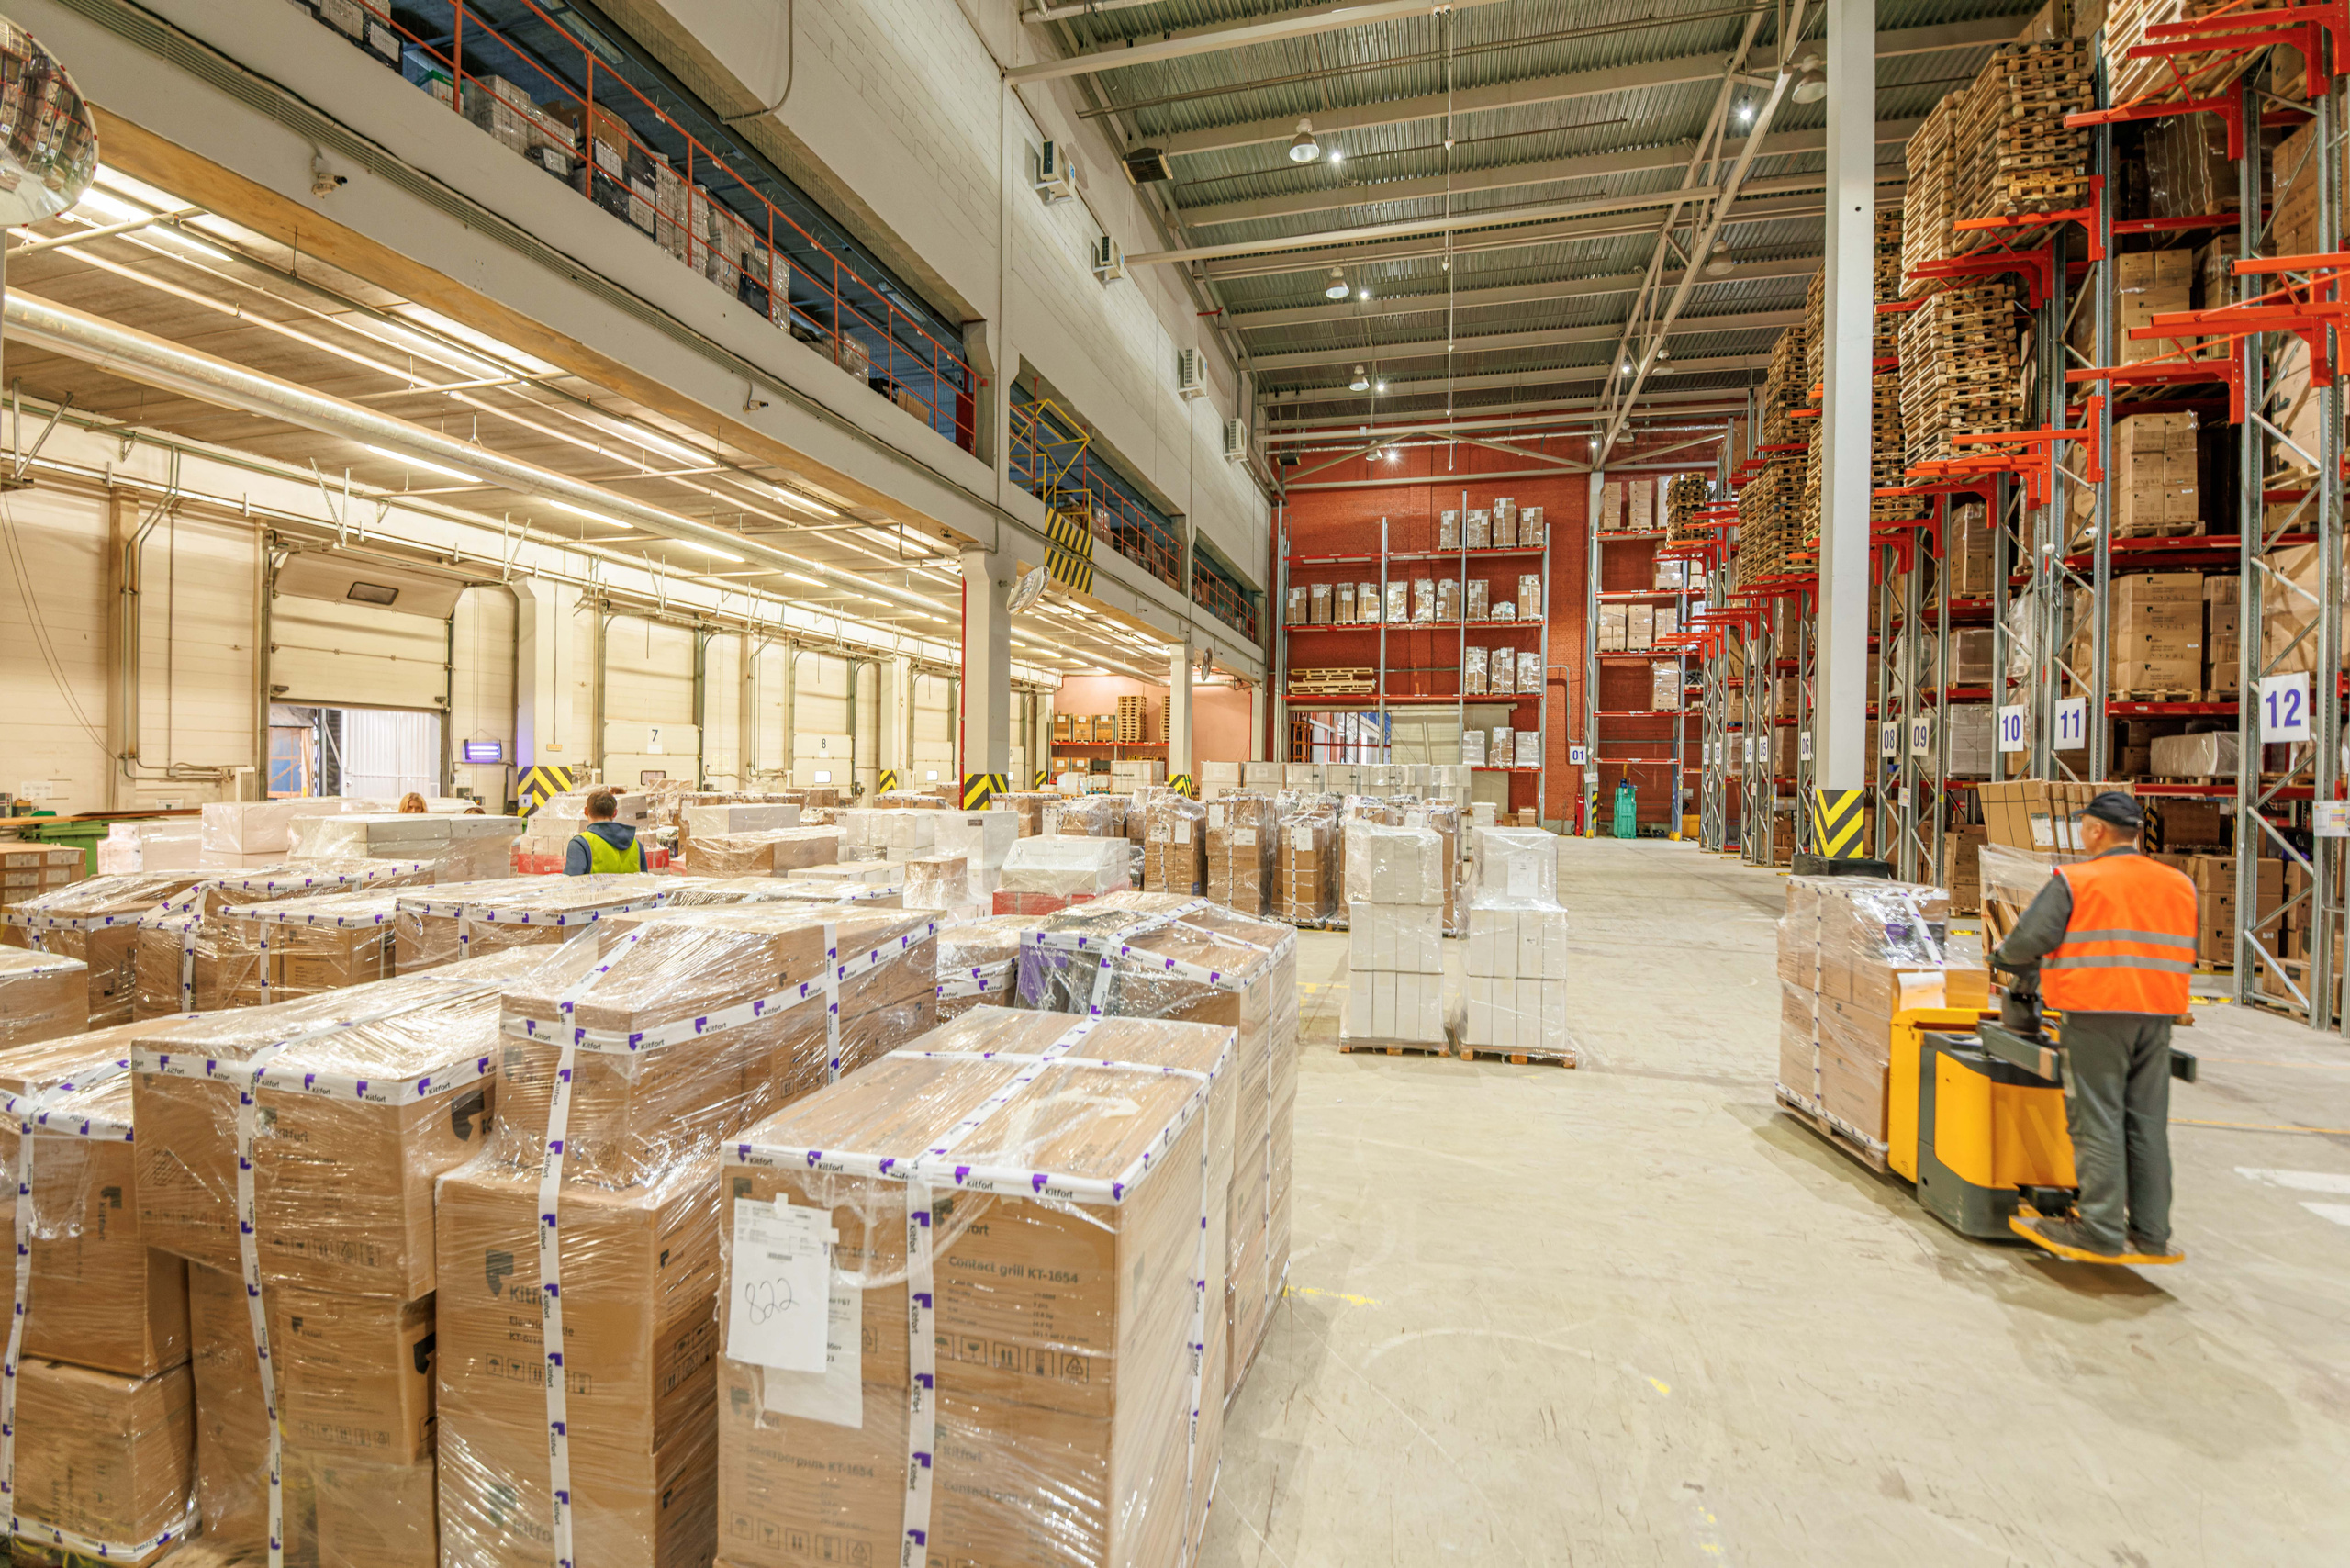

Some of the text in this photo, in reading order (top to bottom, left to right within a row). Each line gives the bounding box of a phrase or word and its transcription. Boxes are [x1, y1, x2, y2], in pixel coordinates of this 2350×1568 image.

[2266, 689, 2301, 728] 12
[2002, 714, 2020, 742] 10
[2060, 709, 2080, 739] 11
[652, 729, 659, 743] 7
[1884, 729, 1895, 750] 08
[1914, 725, 1927, 748] 09
[821, 738, 827, 749] 8
[1802, 737, 1810, 754] 06
[1572, 749, 1584, 761] 01
[763, 1004, 781, 1015] Kitfort
[705, 1023, 727, 1034] Kitfort
[582, 1042, 601, 1050] Kitfort
[641, 1039, 665, 1050] Kitfort
[214, 1072, 230, 1081] Kitfort
[262, 1080, 279, 1089] Kitfort
[429, 1082, 451, 1095] Kitfort
[312, 1087, 331, 1095] Kitfort
[552, 1081, 561, 1106] Kitfort
[365, 1094, 386, 1103] Kitfort
[543, 1152, 552, 1178] Kitfort
[749, 1157, 773, 1166] Kitfort
[818, 1162, 844, 1172] Kitfort
[967, 1179, 993, 1191] Kitfort
[1045, 1187, 1073, 1199] Kitfort
[948, 1256, 1079, 1284] Contact grill KT-1654
[745, 1278, 800, 1326] 822
